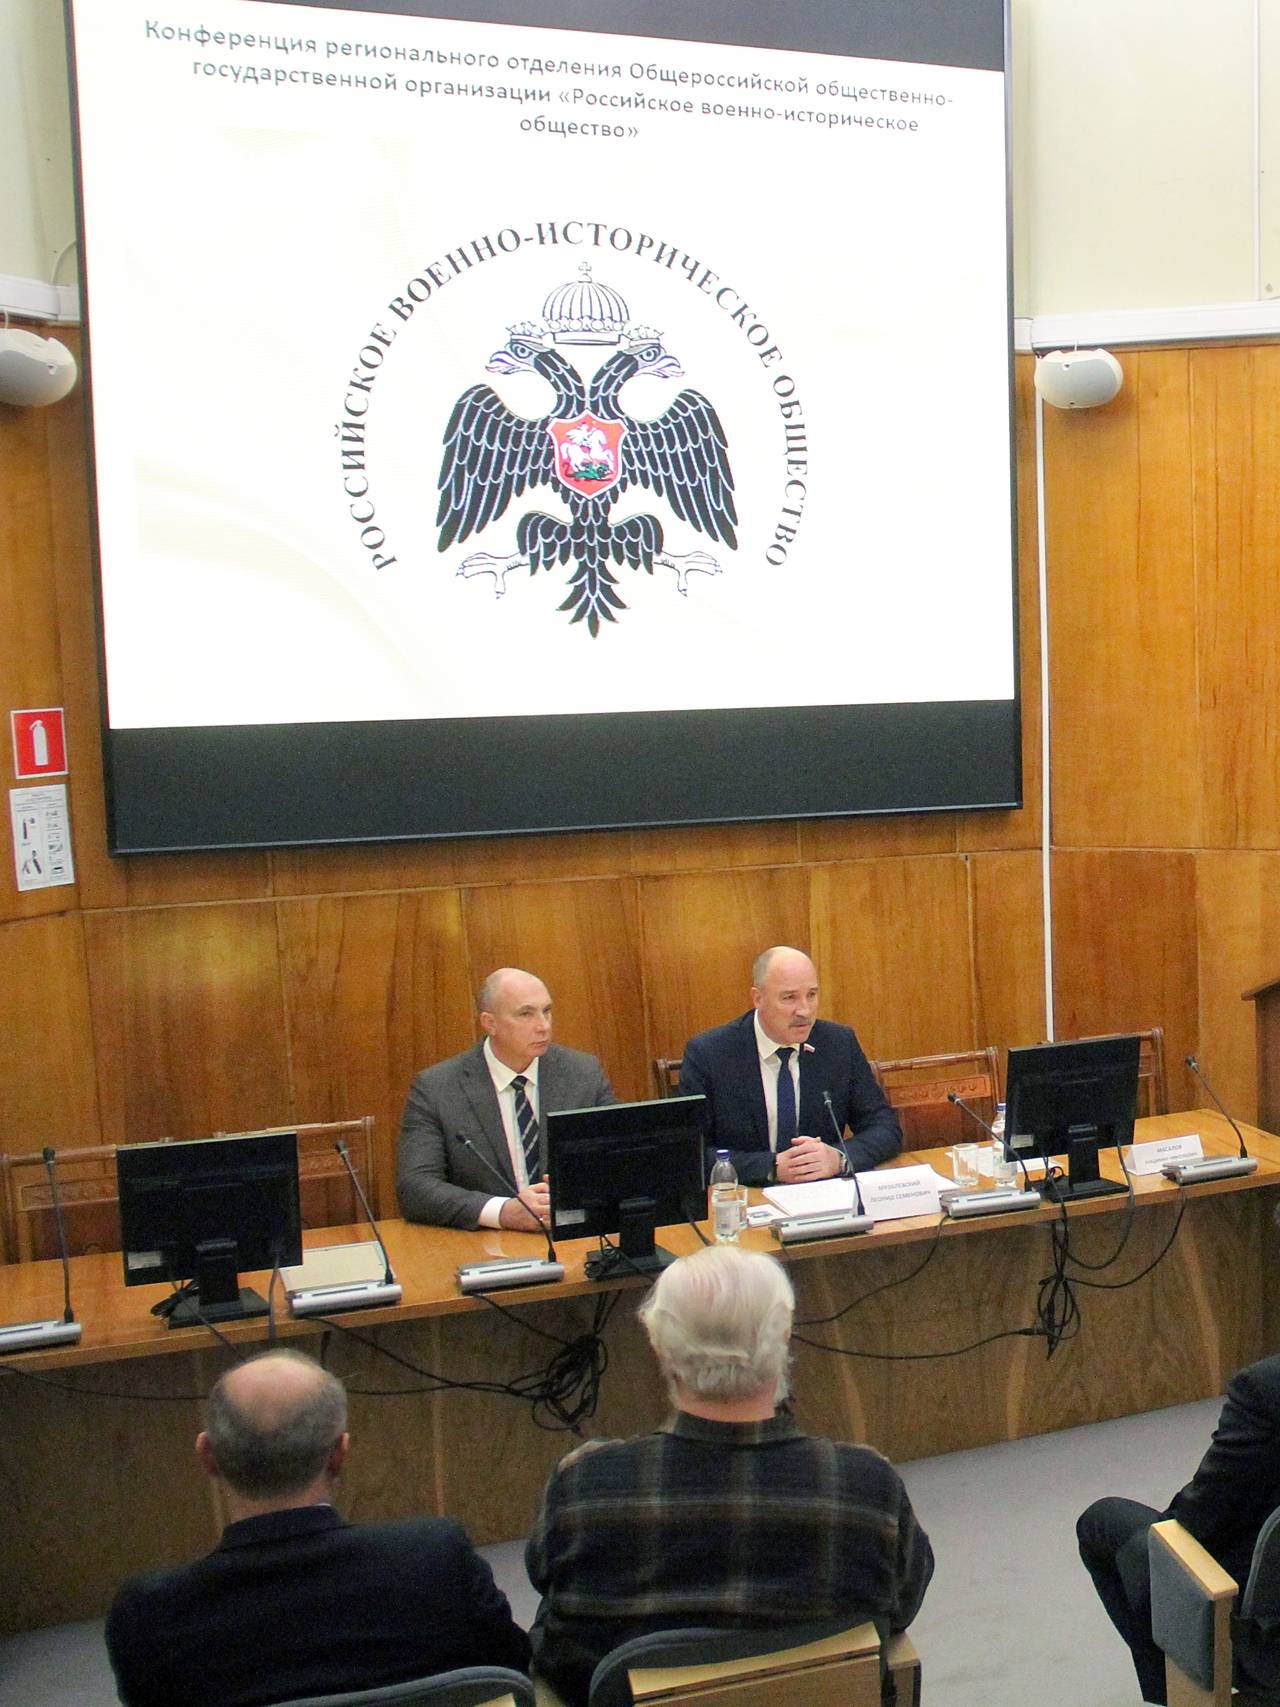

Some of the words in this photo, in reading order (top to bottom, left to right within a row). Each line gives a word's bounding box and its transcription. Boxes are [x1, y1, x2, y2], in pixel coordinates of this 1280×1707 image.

[146, 20, 316, 55] Конференция
[326, 41, 499, 68] регионального
[507, 57, 621, 78] отделения
[630, 63, 808, 94] Общероссийской
[816, 80, 952, 106] общественно-
[194, 62, 397, 90] государственной
[405, 80, 550, 104] организации
[559, 88, 693, 113] «Российское
[702, 103, 918, 131] военно-историческое
[520, 115, 638, 138] общество»
[334, 322, 398, 571] РОССИЙСКОЕ
[388, 222, 782, 368] ВОЕННО-ИСТОРИЧЕСКОЕ
[765, 375, 808, 566] ОБЩЕСТВО
